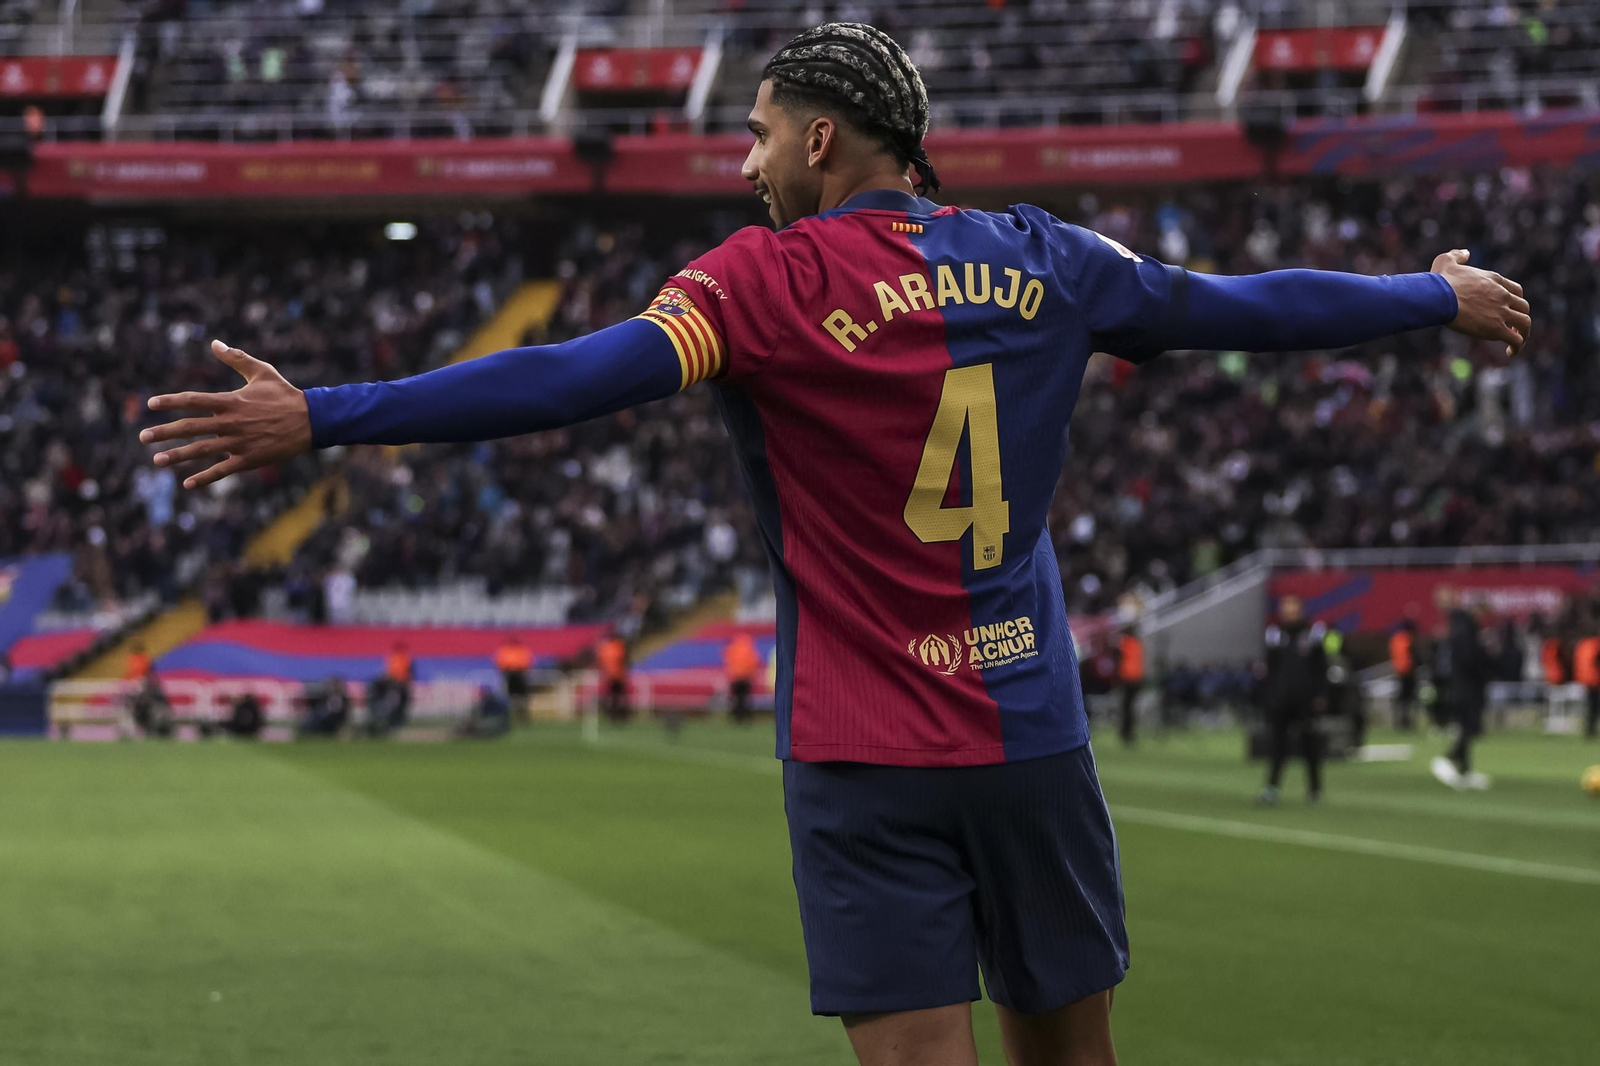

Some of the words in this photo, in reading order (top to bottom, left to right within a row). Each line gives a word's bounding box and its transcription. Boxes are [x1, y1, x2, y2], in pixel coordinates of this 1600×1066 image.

[821, 308, 879, 353] R.
[872, 262, 1045, 322] ARAUJO
[903, 362, 1010, 571] 4
[964, 616, 1034, 645] UNHCR
[968, 632, 1036, 664] ACNUR
[984, 661, 995, 669] UN
